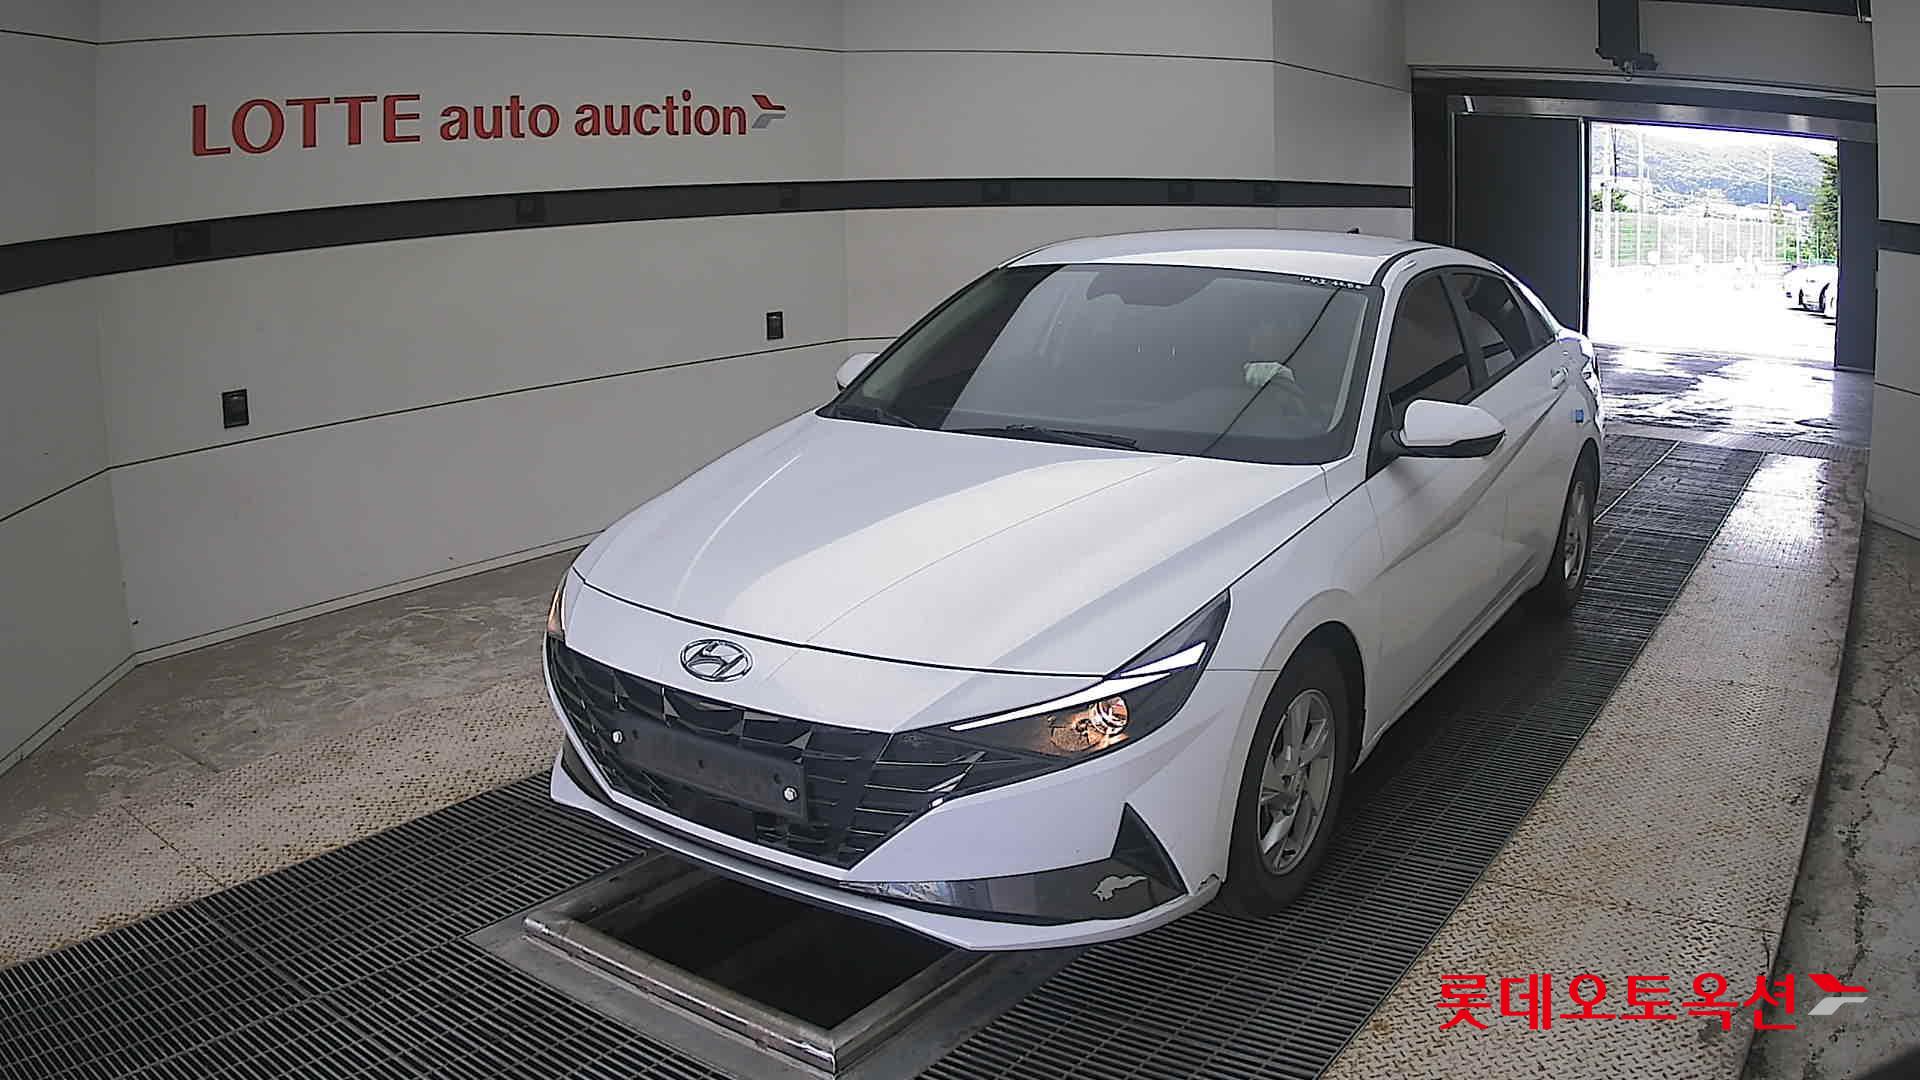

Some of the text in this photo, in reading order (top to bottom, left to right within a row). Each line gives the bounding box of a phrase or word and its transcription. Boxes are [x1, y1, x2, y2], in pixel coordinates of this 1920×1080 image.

[192, 89, 747, 156] LOTTE auto auction
